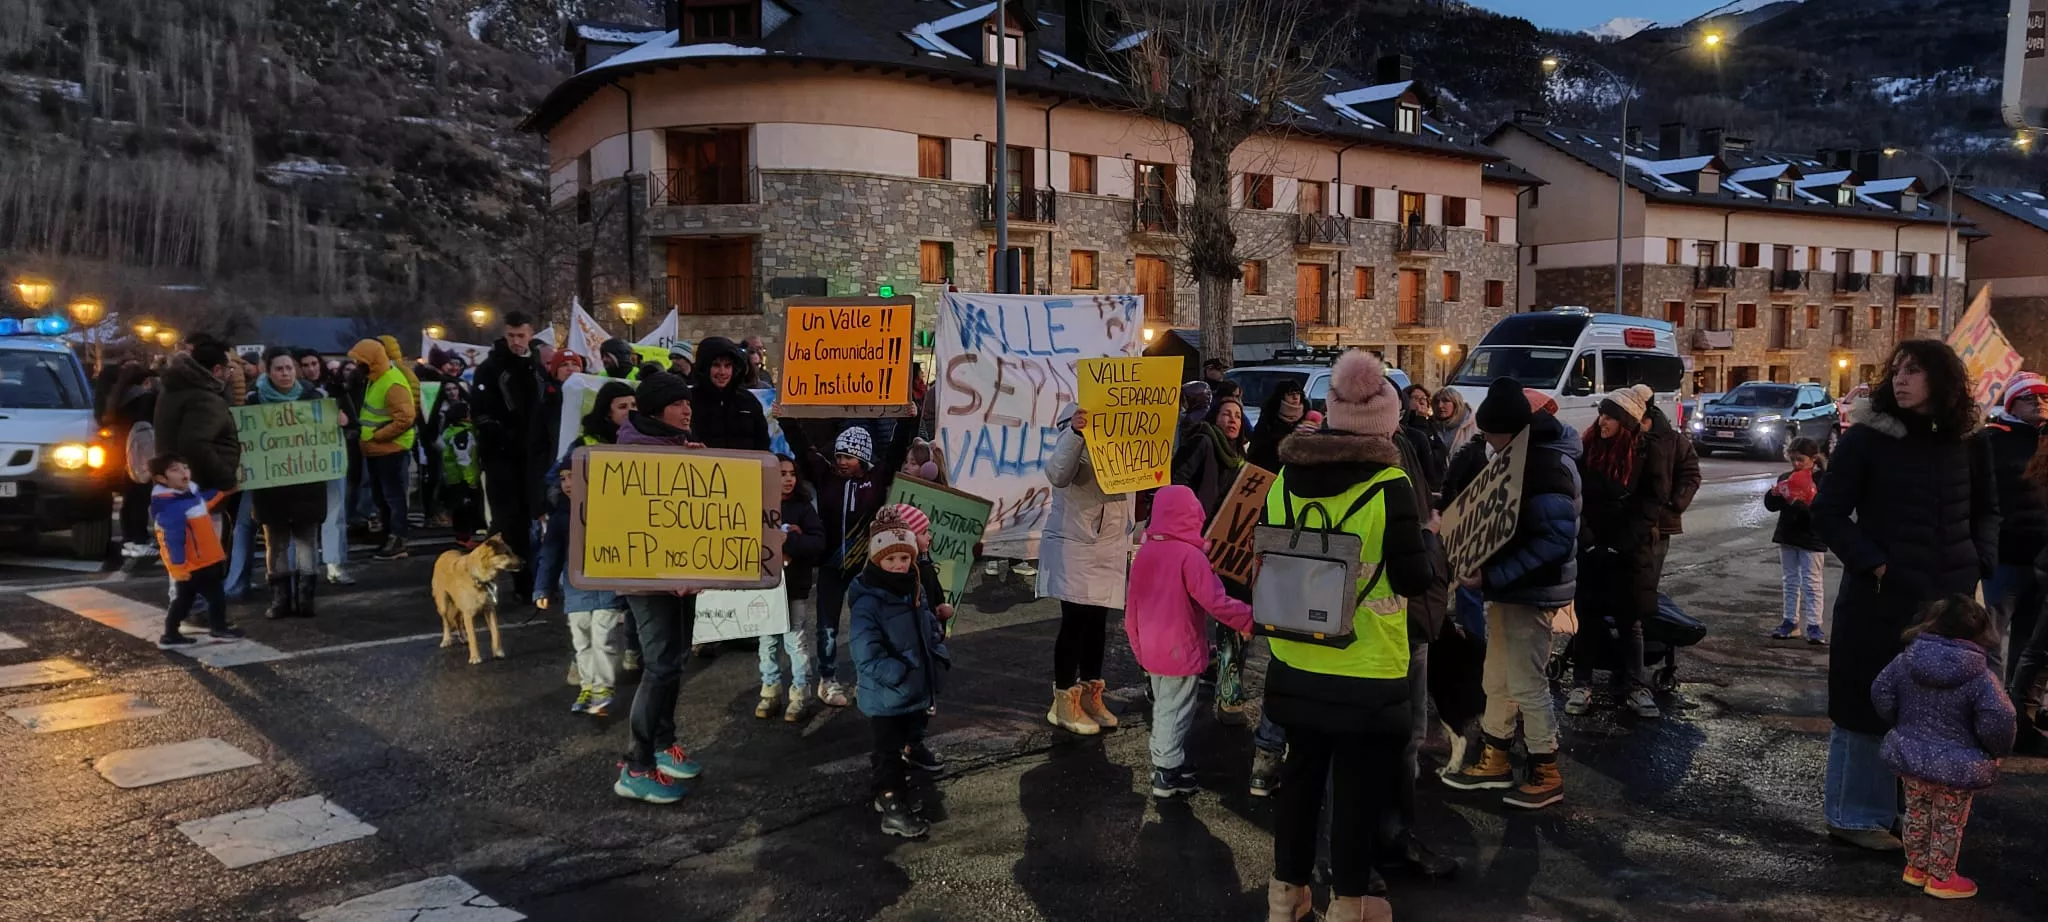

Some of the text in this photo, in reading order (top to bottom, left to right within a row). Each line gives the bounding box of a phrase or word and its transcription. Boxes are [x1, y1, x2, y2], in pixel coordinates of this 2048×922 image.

[802, 312, 825, 331] Un
[829, 308, 872, 331] Valle
[788, 341, 811, 361] Una
[814, 338, 884, 361] Comunidad
[787, 375, 808, 397] Un
[814, 372, 874, 396] Instituto
[1088, 361, 1143, 385] VALLE
[1105, 386, 1178, 408] SEPARADO
[1092, 411, 1161, 441] FUTURO
[265, 450, 328, 480] Instituto
[1091, 439, 1170, 477] AMENAZADO
[602, 460, 728, 499] MALLADA
[1456, 446, 1512, 517] TODOS
[648, 499, 748, 532] ESCUCHA
[593, 546, 621, 565] UNA
[628, 532, 658, 568] FP
[692, 535, 762, 574] GUSTA
